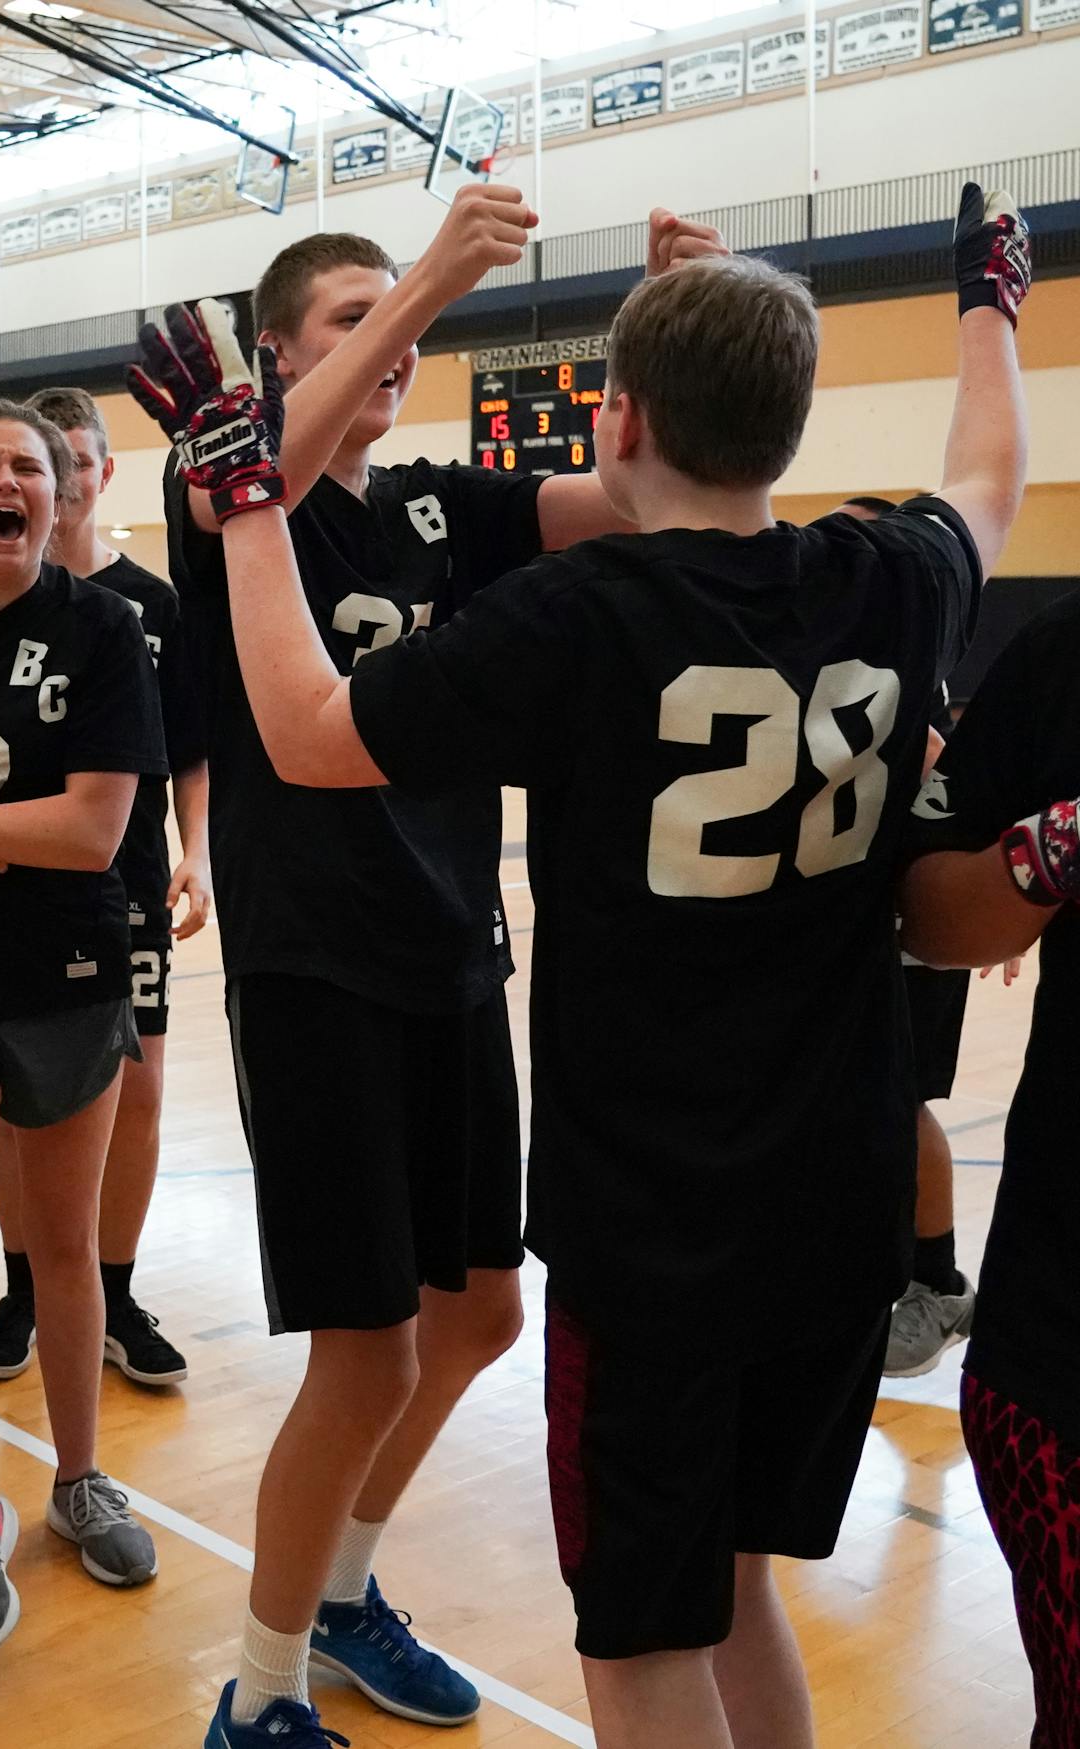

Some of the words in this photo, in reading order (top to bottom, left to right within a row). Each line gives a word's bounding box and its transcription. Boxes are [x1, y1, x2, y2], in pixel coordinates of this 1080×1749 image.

[558, 363, 573, 390] 8
[491, 414, 510, 440] 15
[538, 412, 550, 434] 3
[191, 424, 252, 465] Franklin
[571, 443, 585, 466] 0
[503, 448, 516, 470] 0
[647, 658, 901, 898] 28
[128, 901, 142, 911] XL
[75, 949, 86, 960] L
